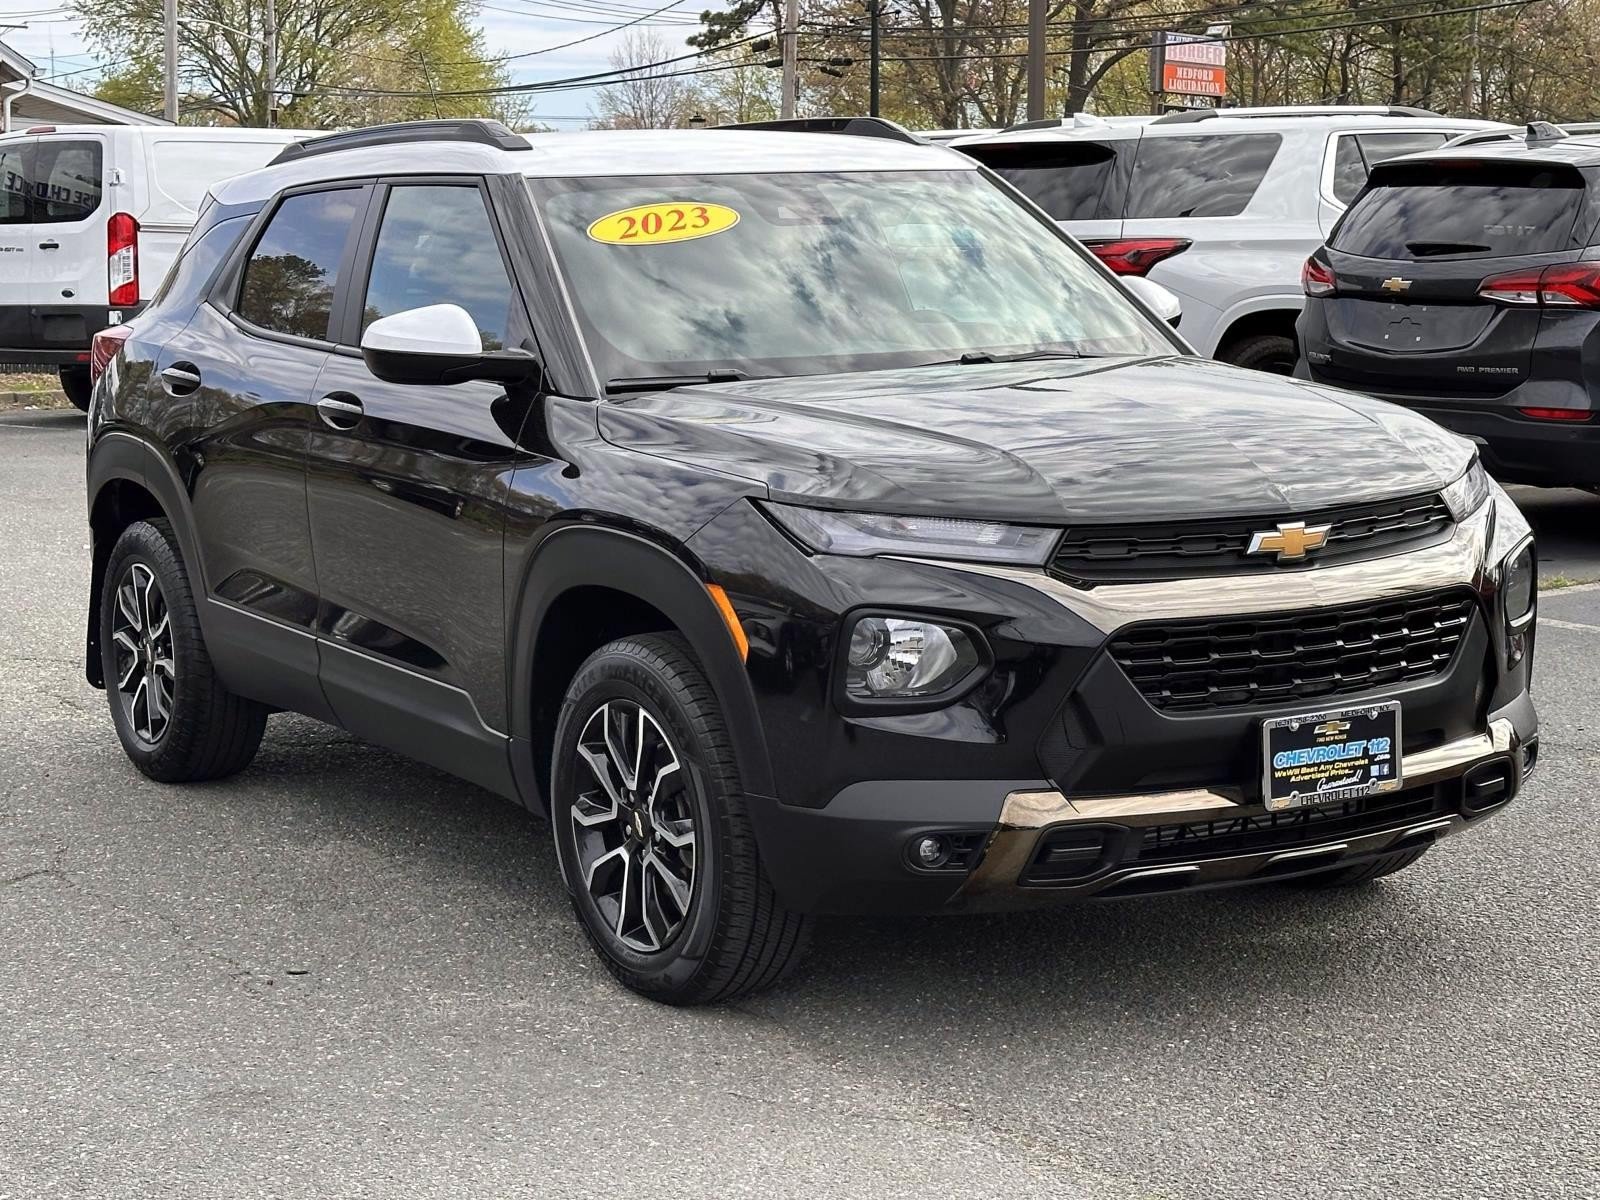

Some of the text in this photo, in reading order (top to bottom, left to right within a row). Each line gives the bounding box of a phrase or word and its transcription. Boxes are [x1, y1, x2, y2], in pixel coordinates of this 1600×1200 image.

[1176, 67, 1214, 81] MEDFORD
[1168, 78, 1220, 94] LIQUIDATION
[617, 207, 711, 239] 2023
[1273, 737, 1391, 769] CHEVROLET 112
[1318, 763, 1334, 774] Any
[1334, 758, 1369, 770] Chevrolet
[1289, 769, 1329, 783] Advertised
[1300, 786, 1370, 806] CHEVROLET 112
